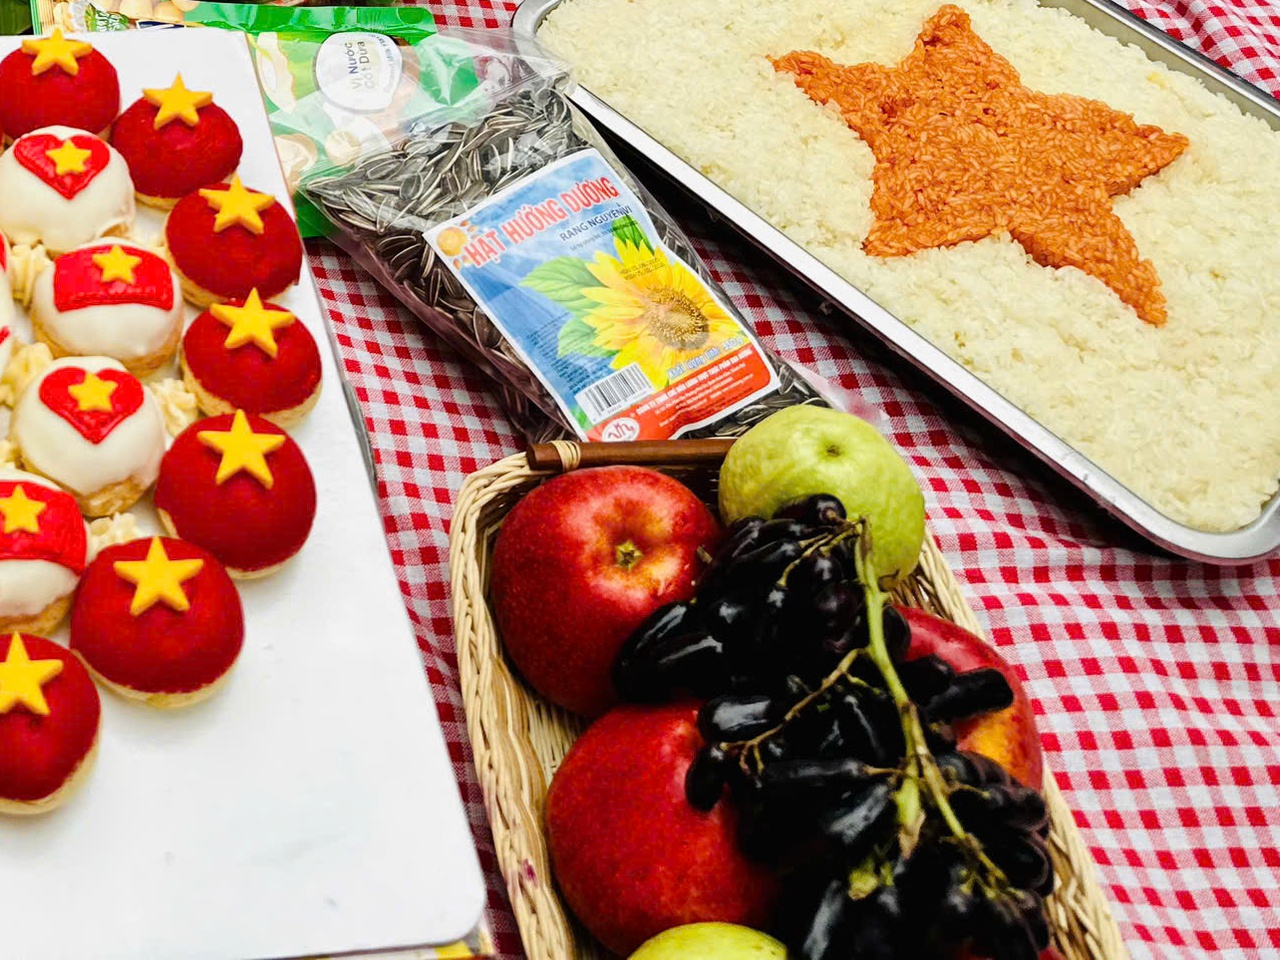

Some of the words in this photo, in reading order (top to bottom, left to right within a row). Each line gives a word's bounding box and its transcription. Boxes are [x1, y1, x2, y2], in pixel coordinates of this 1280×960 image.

[463, 228, 507, 268] HẠT
[501, 197, 568, 245] HƯỚNG
[560, 176, 620, 214] DƯƠNG
[559, 222, 588, 242] RANG
